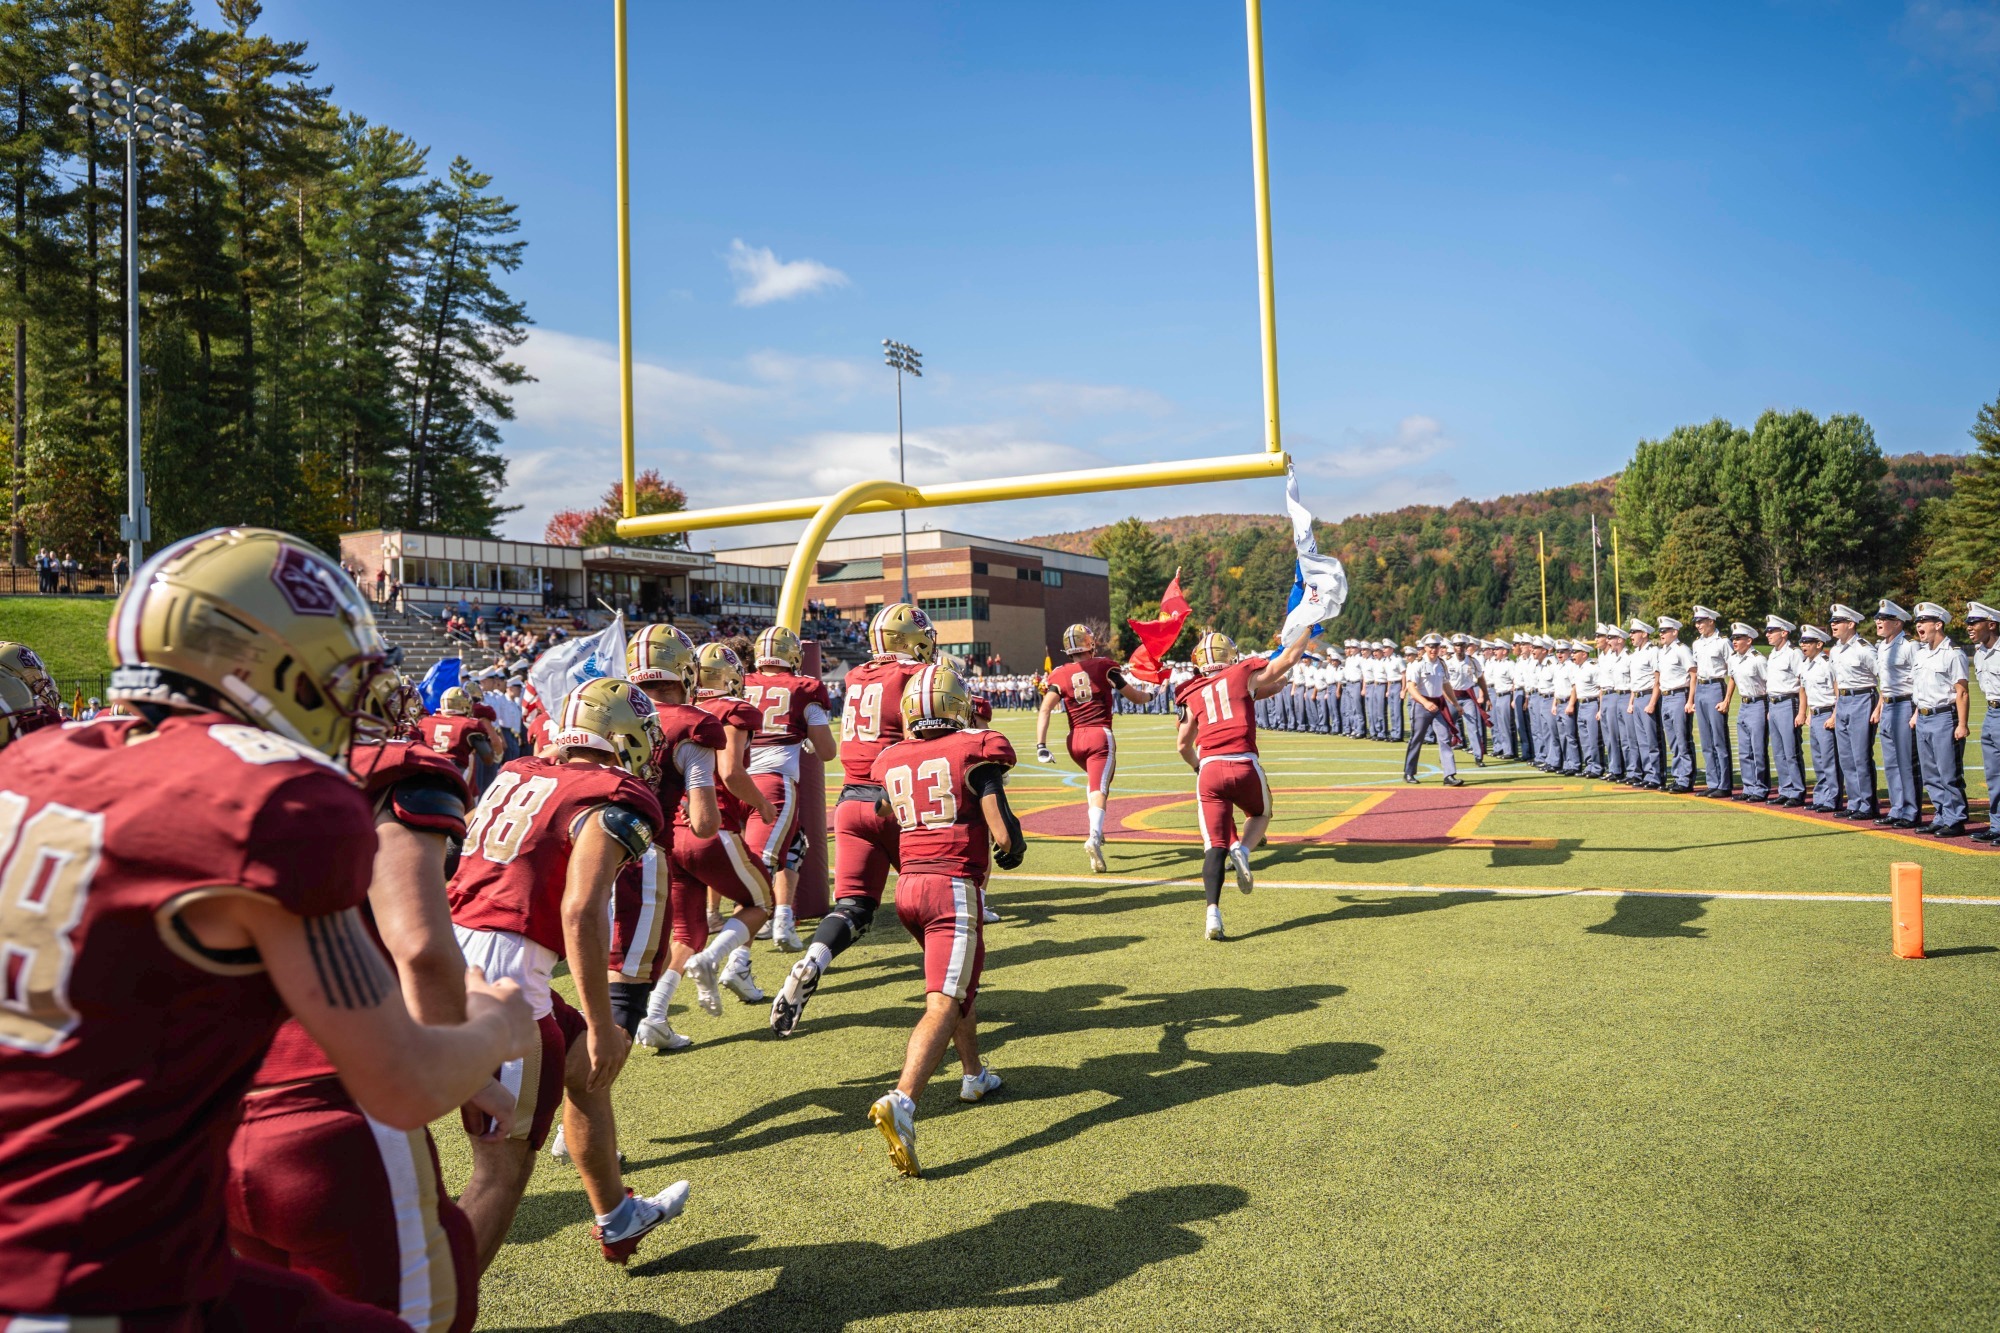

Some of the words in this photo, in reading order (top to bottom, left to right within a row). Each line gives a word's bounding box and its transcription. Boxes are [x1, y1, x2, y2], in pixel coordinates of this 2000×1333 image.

[630, 672, 662, 682] Riddell
[1071, 671, 1092, 705] 8
[744, 686, 792, 734] 72
[841, 683, 883, 741] 69
[918, 718, 942, 727] schutt
[1201, 678, 1233, 724] 11
[432, 724, 453, 753] 5
[885, 757, 957, 832] 83
[461, 771, 558, 865] 88
